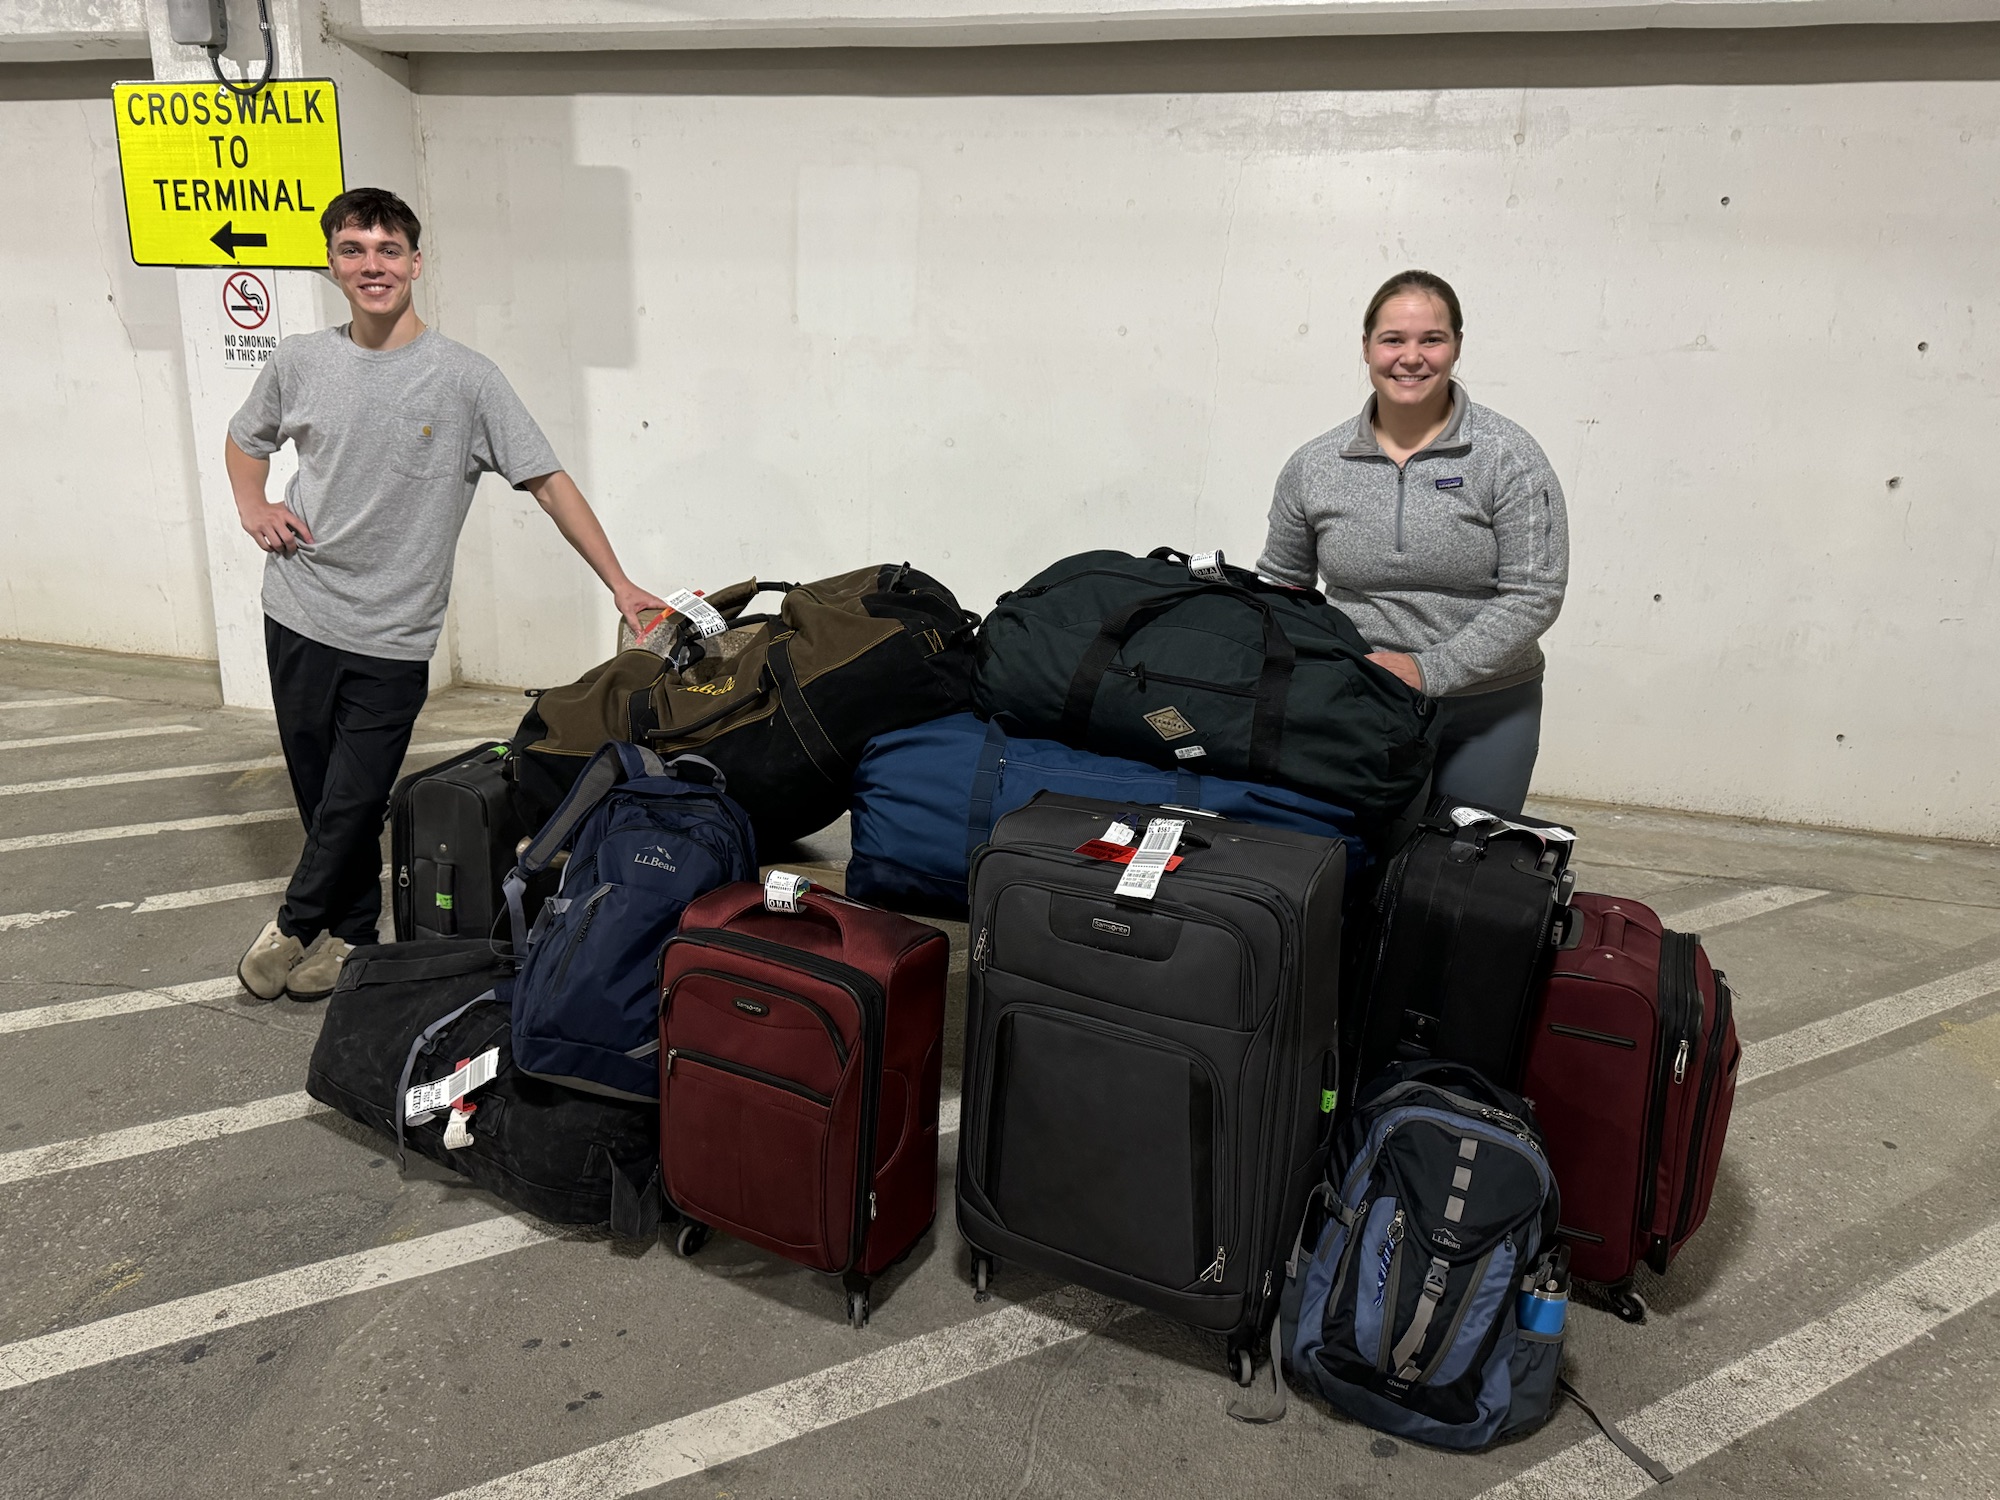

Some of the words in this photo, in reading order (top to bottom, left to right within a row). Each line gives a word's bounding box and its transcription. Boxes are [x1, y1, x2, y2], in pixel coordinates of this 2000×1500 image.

[127, 89, 324, 125] CROSSWALK
[209, 135, 248, 168] TO
[153, 178, 315, 212] TERMINAL
[224, 334, 236, 347] NO
[238, 335, 277, 348] SMOKING
[225, 348, 235, 360] IN
[236, 349, 255, 361] THIS
[257, 350, 273, 361] AR
[769, 899, 791, 910] OMA
